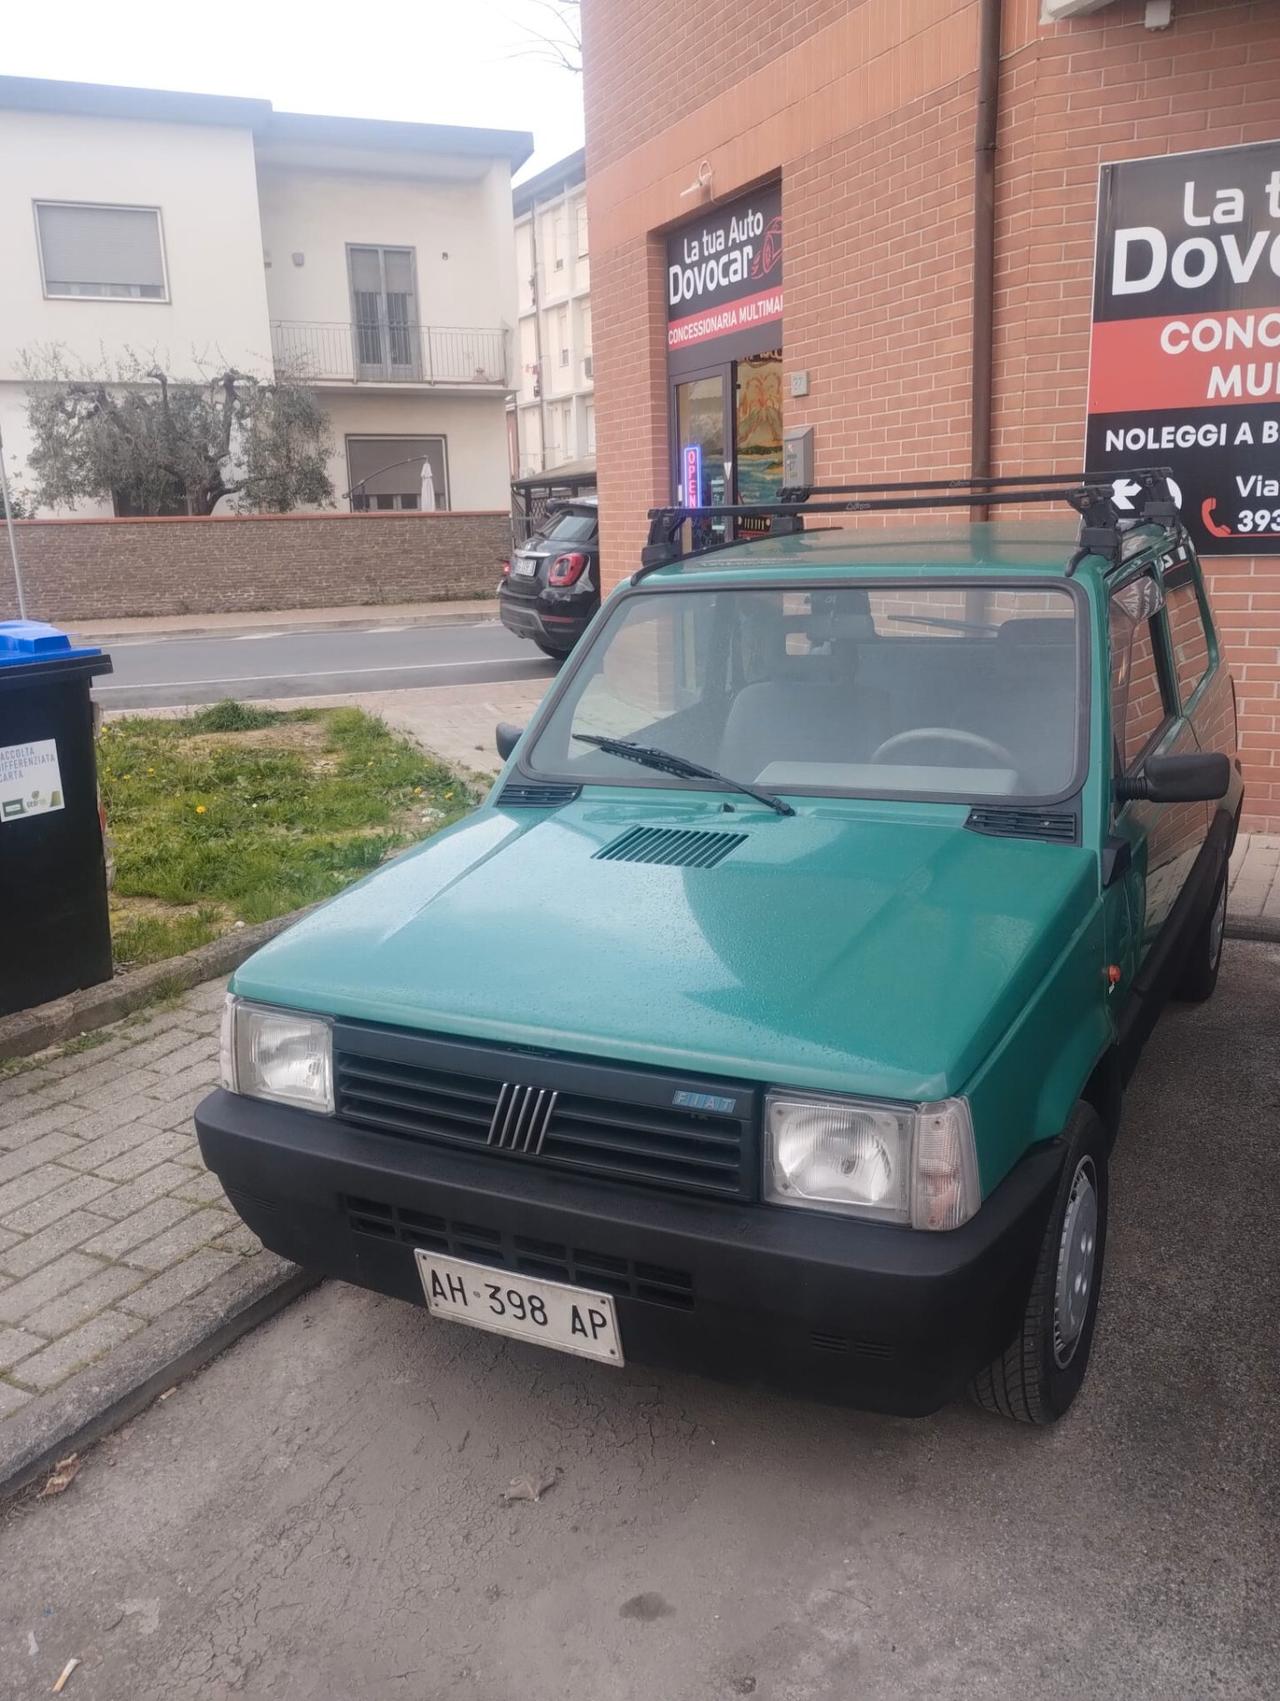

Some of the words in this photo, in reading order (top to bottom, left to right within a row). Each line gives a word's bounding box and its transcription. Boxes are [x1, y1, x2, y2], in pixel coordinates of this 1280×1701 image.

[1183, 180, 1245, 227] La
[684, 237, 700, 264] La
[702, 229, 725, 257] tua
[728, 209, 764, 246] Auto
[668, 244, 753, 306] Dovocar
[1112, 226, 1280, 296] Dov
[668, 313, 738, 346] CONCESSIONARIA
[1206, 361, 1280, 399] MU
[1105, 423, 1227, 452] NOLEGGI
[1234, 421, 1254, 446] A
[687, 450, 697, 509] OPEN
[1235, 475, 1279, 498] Via
[676, 1090, 736, 1113] FIAT
[431, 1269, 468, 1307] AH
[484, 1283, 548, 1327] 398
[571, 1304, 607, 1340] AP
